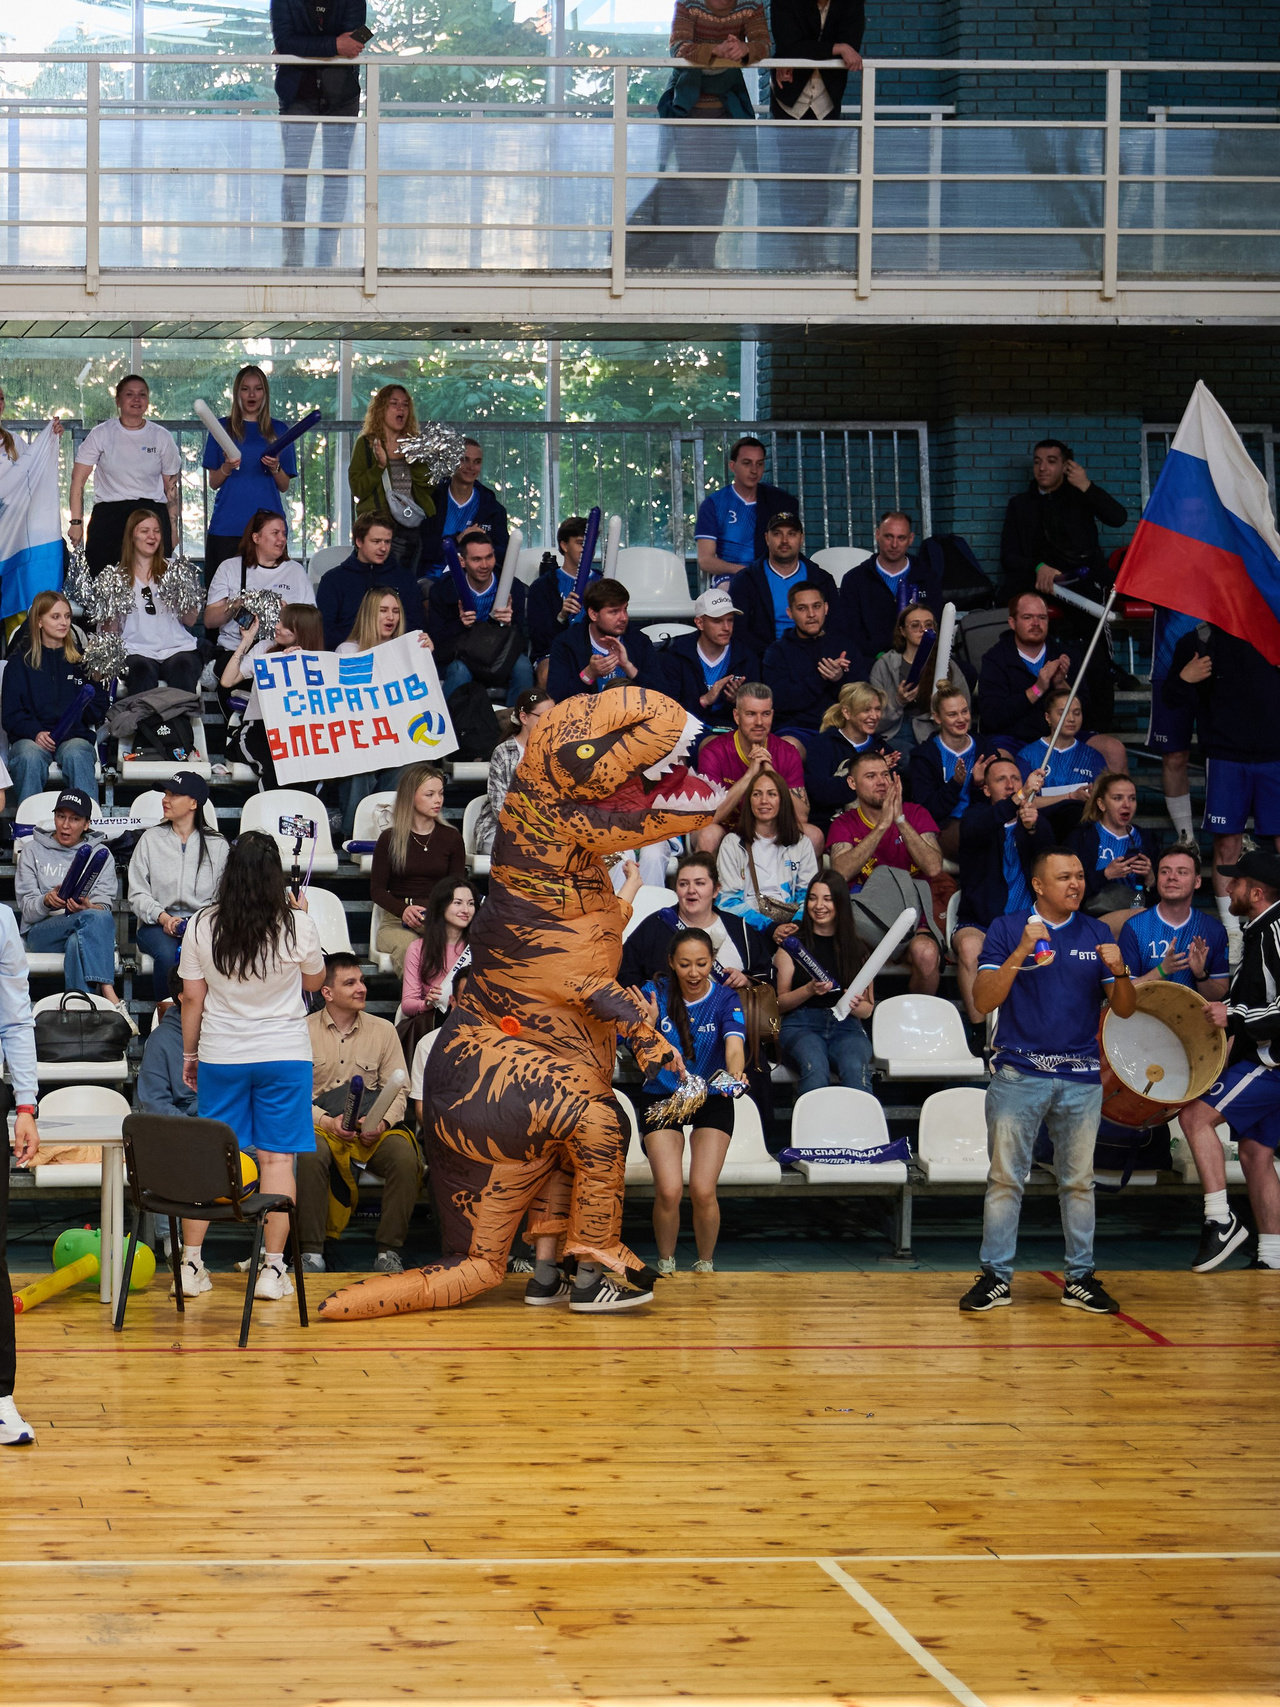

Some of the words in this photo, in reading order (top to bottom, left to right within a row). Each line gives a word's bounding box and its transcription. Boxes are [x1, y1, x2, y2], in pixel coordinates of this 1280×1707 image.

[728, 510, 738, 524] 3
[253, 654, 324, 690] ВТБ
[283, 673, 429, 716] САРАТОВ
[267, 716, 400, 761] ВПЕРЕД
[1155, 734, 1168, 743] ВТБ
[61, 794, 82, 806] ПЕНЗА
[1211, 815, 1226, 825] ВТБ
[1079, 951, 1097, 961] ВТБ
[1148, 939, 1170, 959] 12
[660, 1015, 672, 1033] 6
[799, 1149, 813, 1157] XII
[814, 1147, 884, 1159] СПАРТАКИАДА
